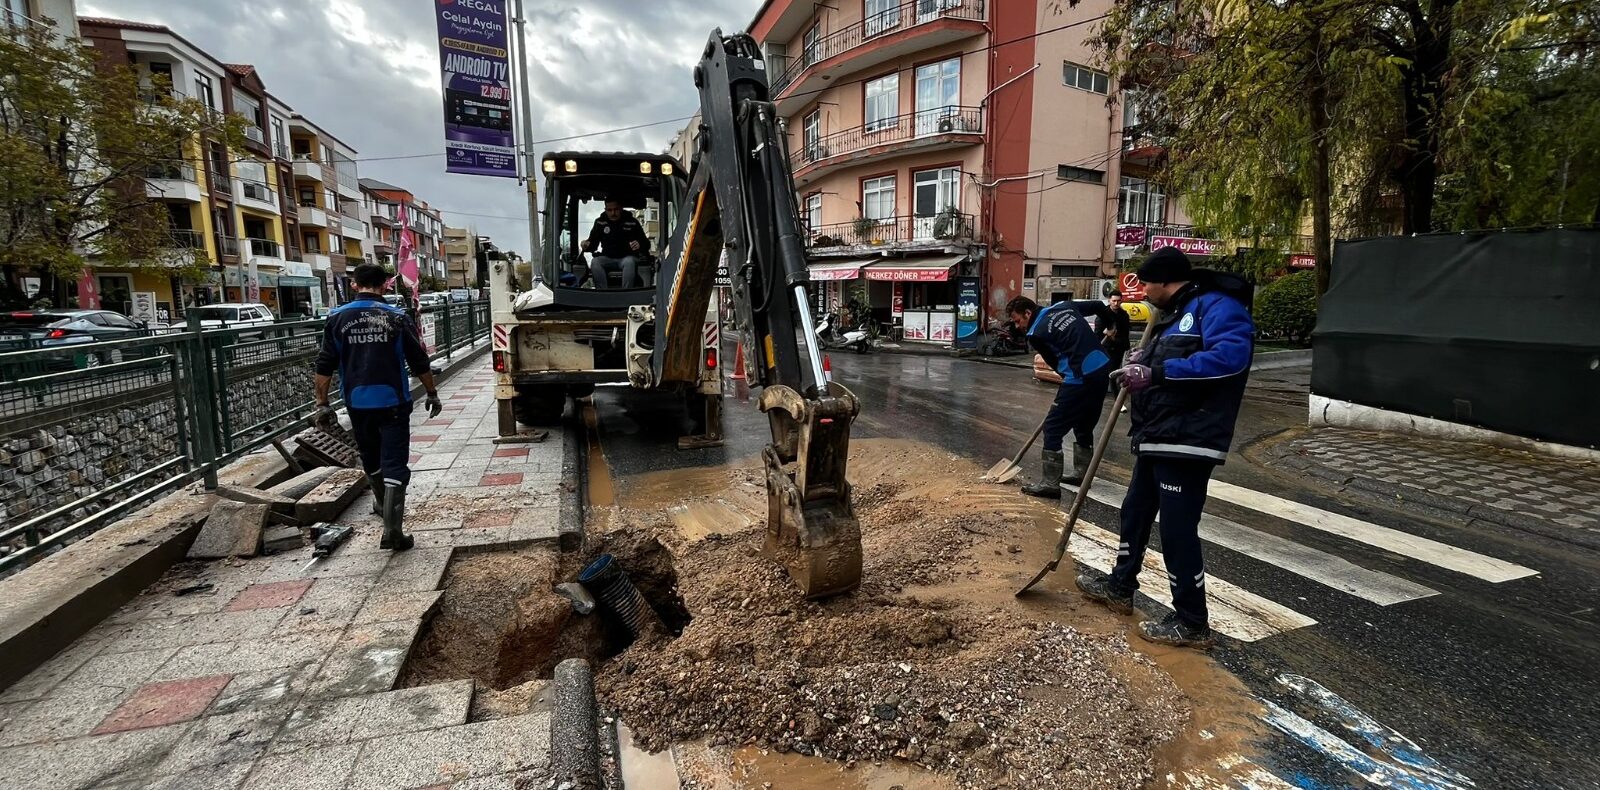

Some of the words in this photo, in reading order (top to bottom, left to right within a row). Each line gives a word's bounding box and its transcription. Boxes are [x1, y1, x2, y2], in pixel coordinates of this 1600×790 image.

[457, 0, 502, 15] REGAL
[442, 10, 470, 25] Celal
[473, 17, 502, 32] Aydın
[444, 53, 491, 78] ANDROİD
[493, 61, 508, 81] TV
[480, 85, 502, 100] 12.999
[503, 88, 511, 101] TL
[865, 271, 893, 280] MERKEZ
[894, 270, 919, 280] DÖNER
[347, 332, 388, 344] MUSKİ
